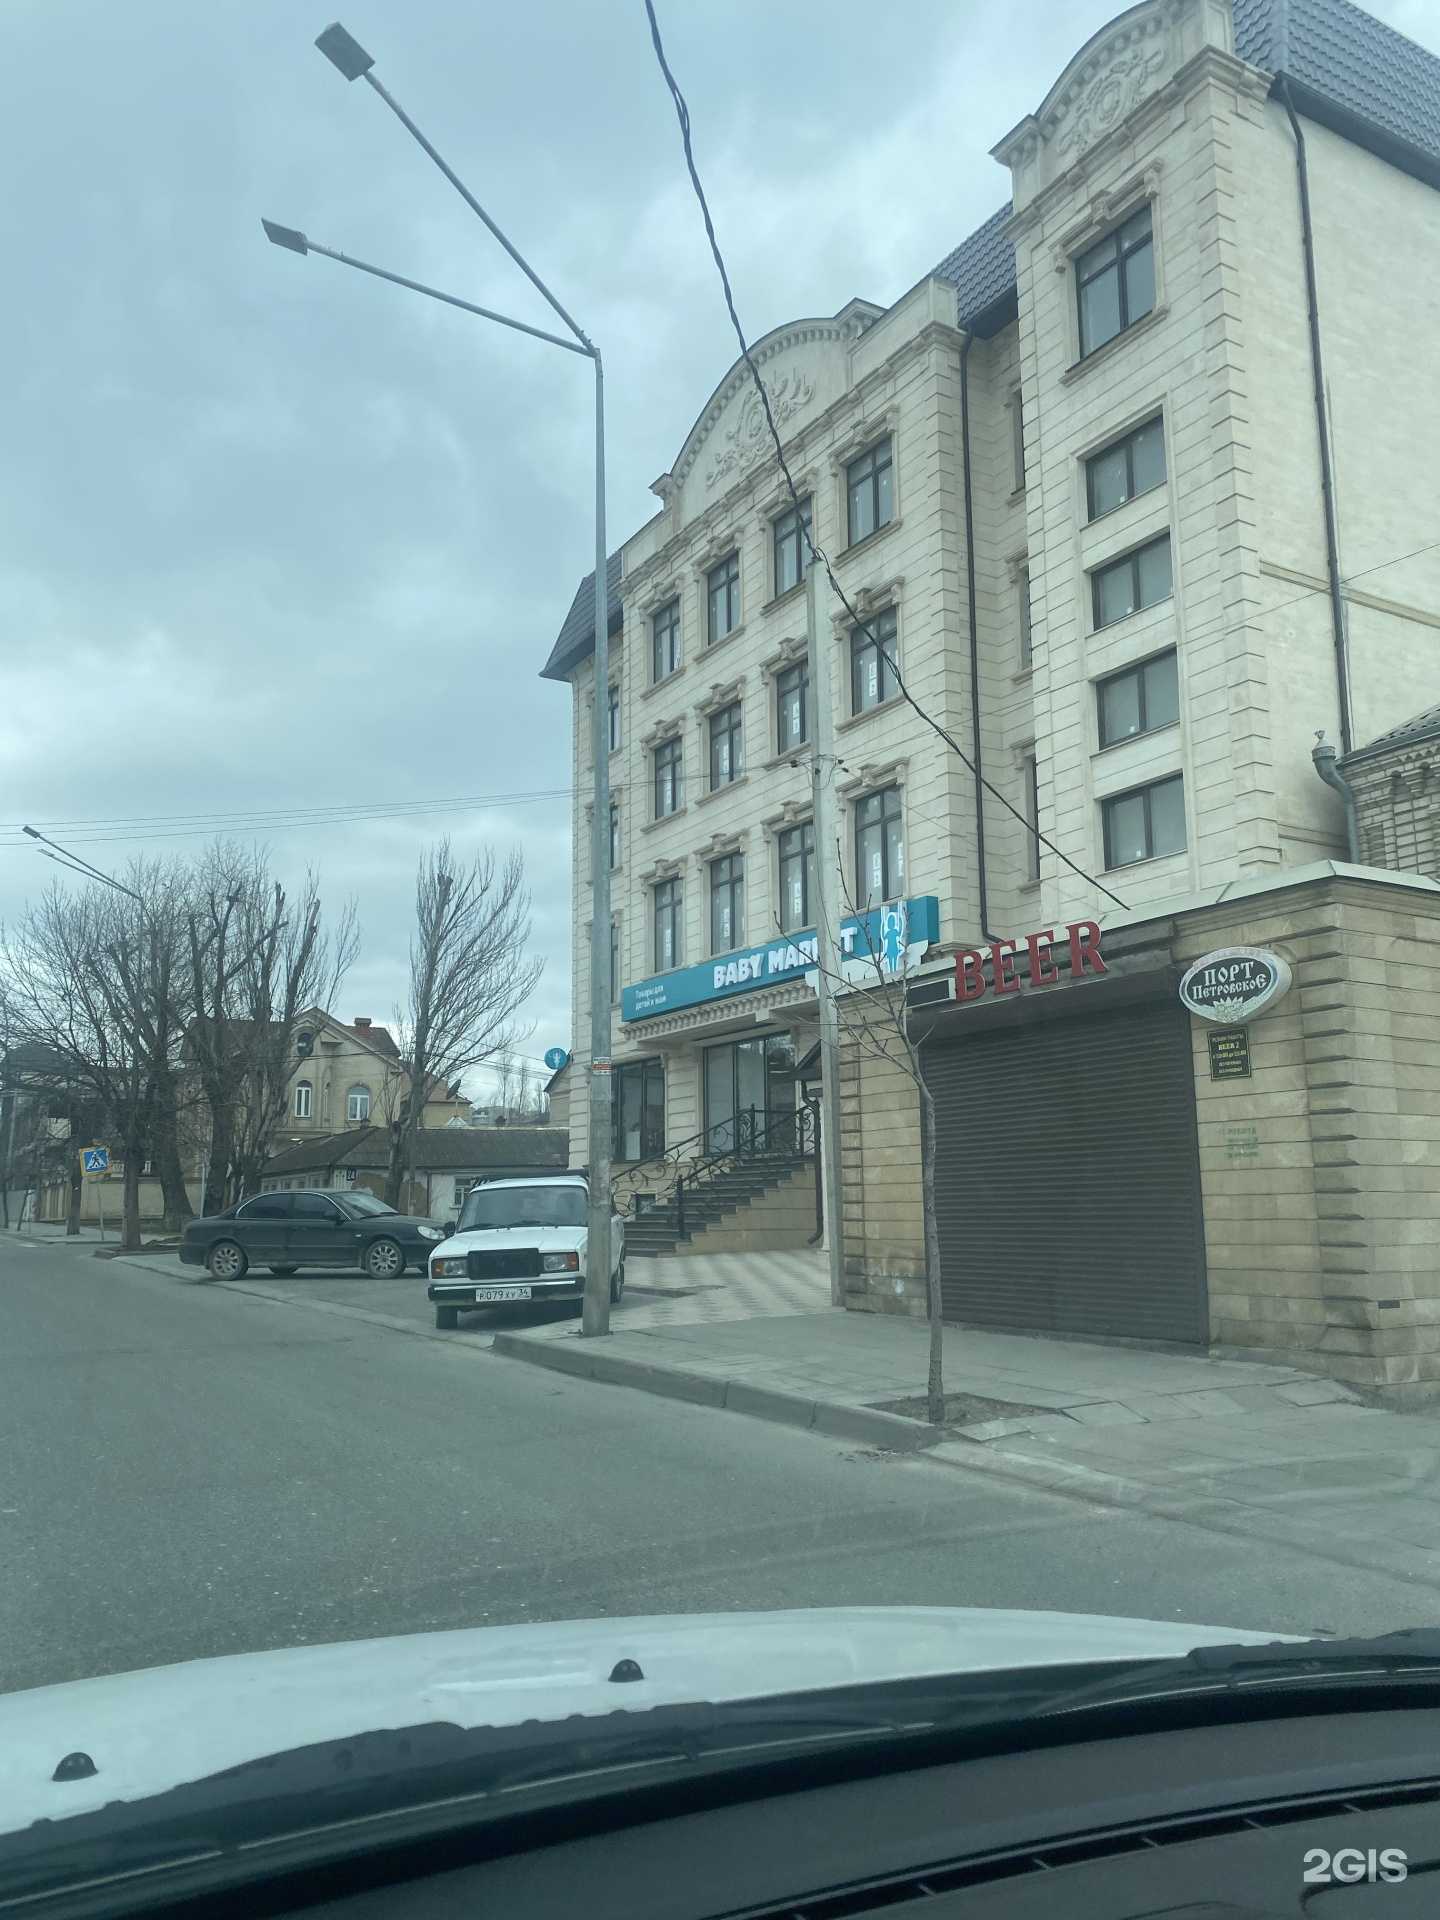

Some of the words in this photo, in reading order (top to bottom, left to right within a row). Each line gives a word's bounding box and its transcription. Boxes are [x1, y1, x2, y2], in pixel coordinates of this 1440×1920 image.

[713, 953, 765, 989] BABY
[954, 920, 1109, 1002] BEER
[1203, 961, 1254, 987] ПОРТ
